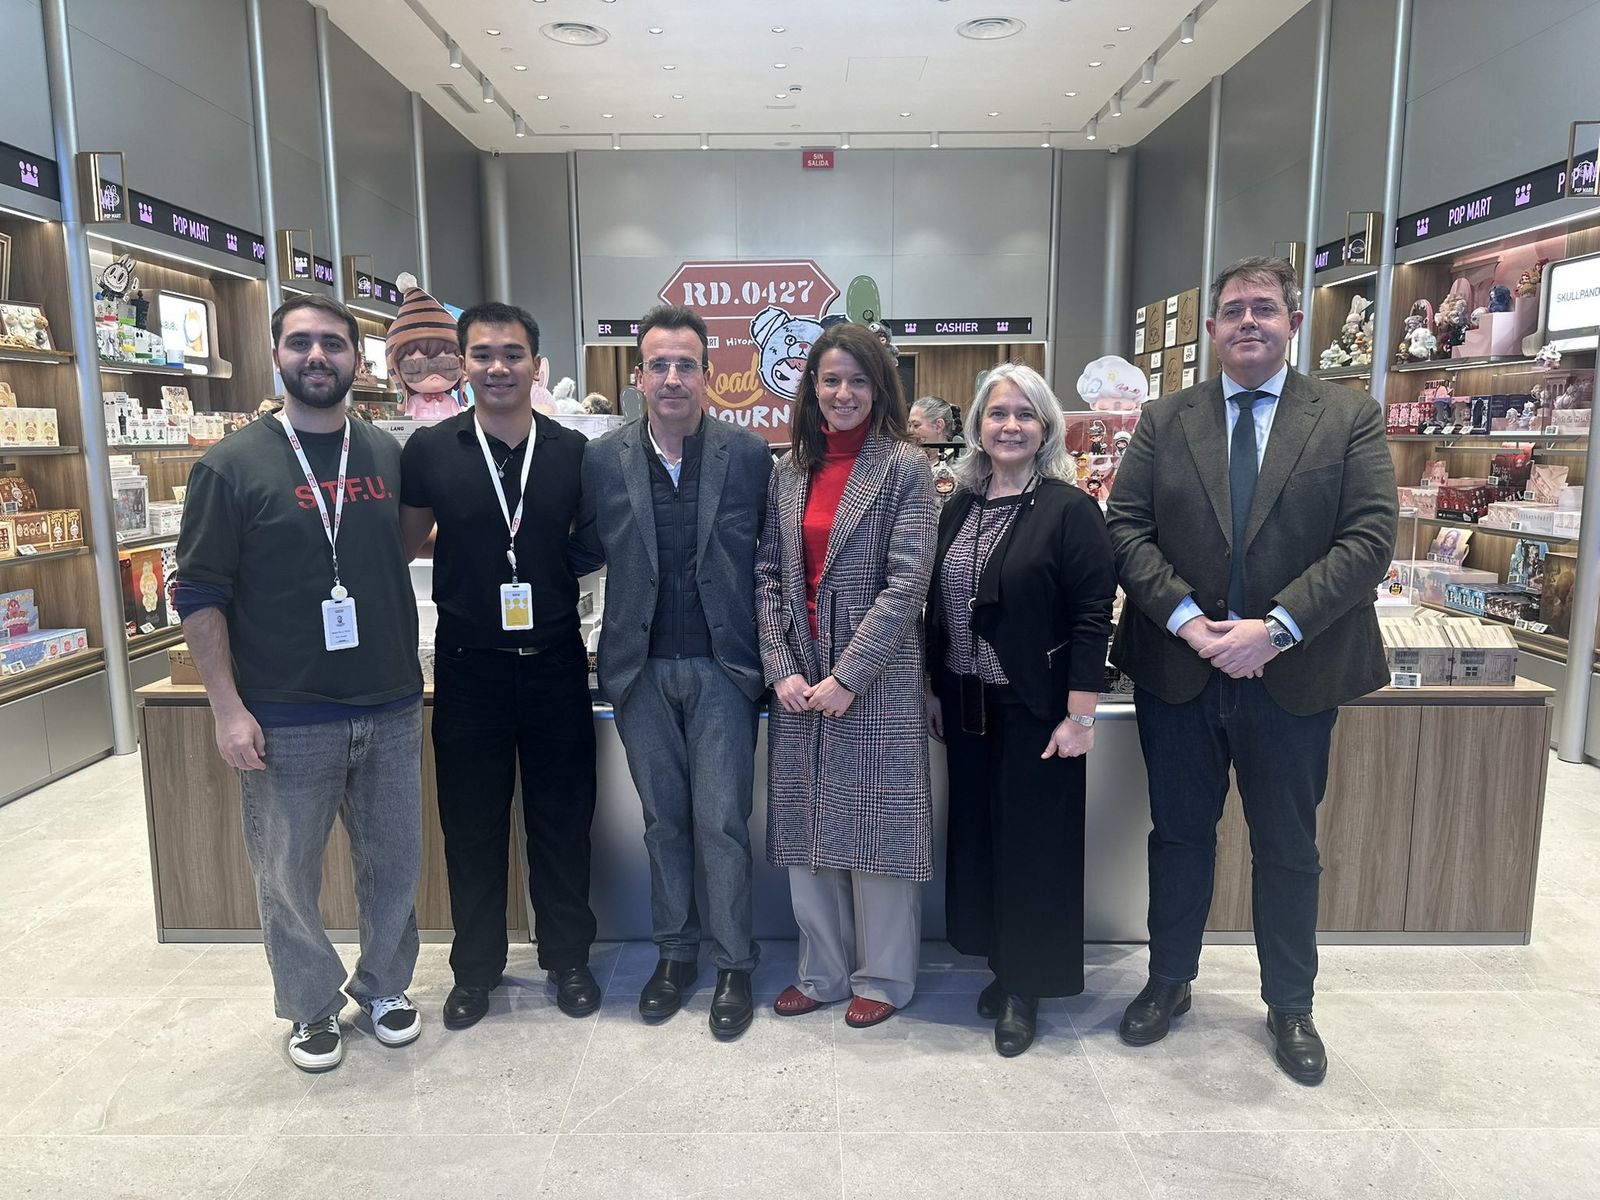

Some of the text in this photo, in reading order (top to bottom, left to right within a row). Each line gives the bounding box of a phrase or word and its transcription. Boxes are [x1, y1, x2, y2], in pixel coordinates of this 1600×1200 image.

[1448, 196, 1492, 227] POP MART
[172, 213, 210, 242] POP MART
[252, 241, 265, 260] POP
[682, 280, 814, 307] RD.0427
[935, 322, 978, 333] CASHIER
[726, 337, 754, 347] Hiron
[294, 475, 393, 509] ST.F.U.
